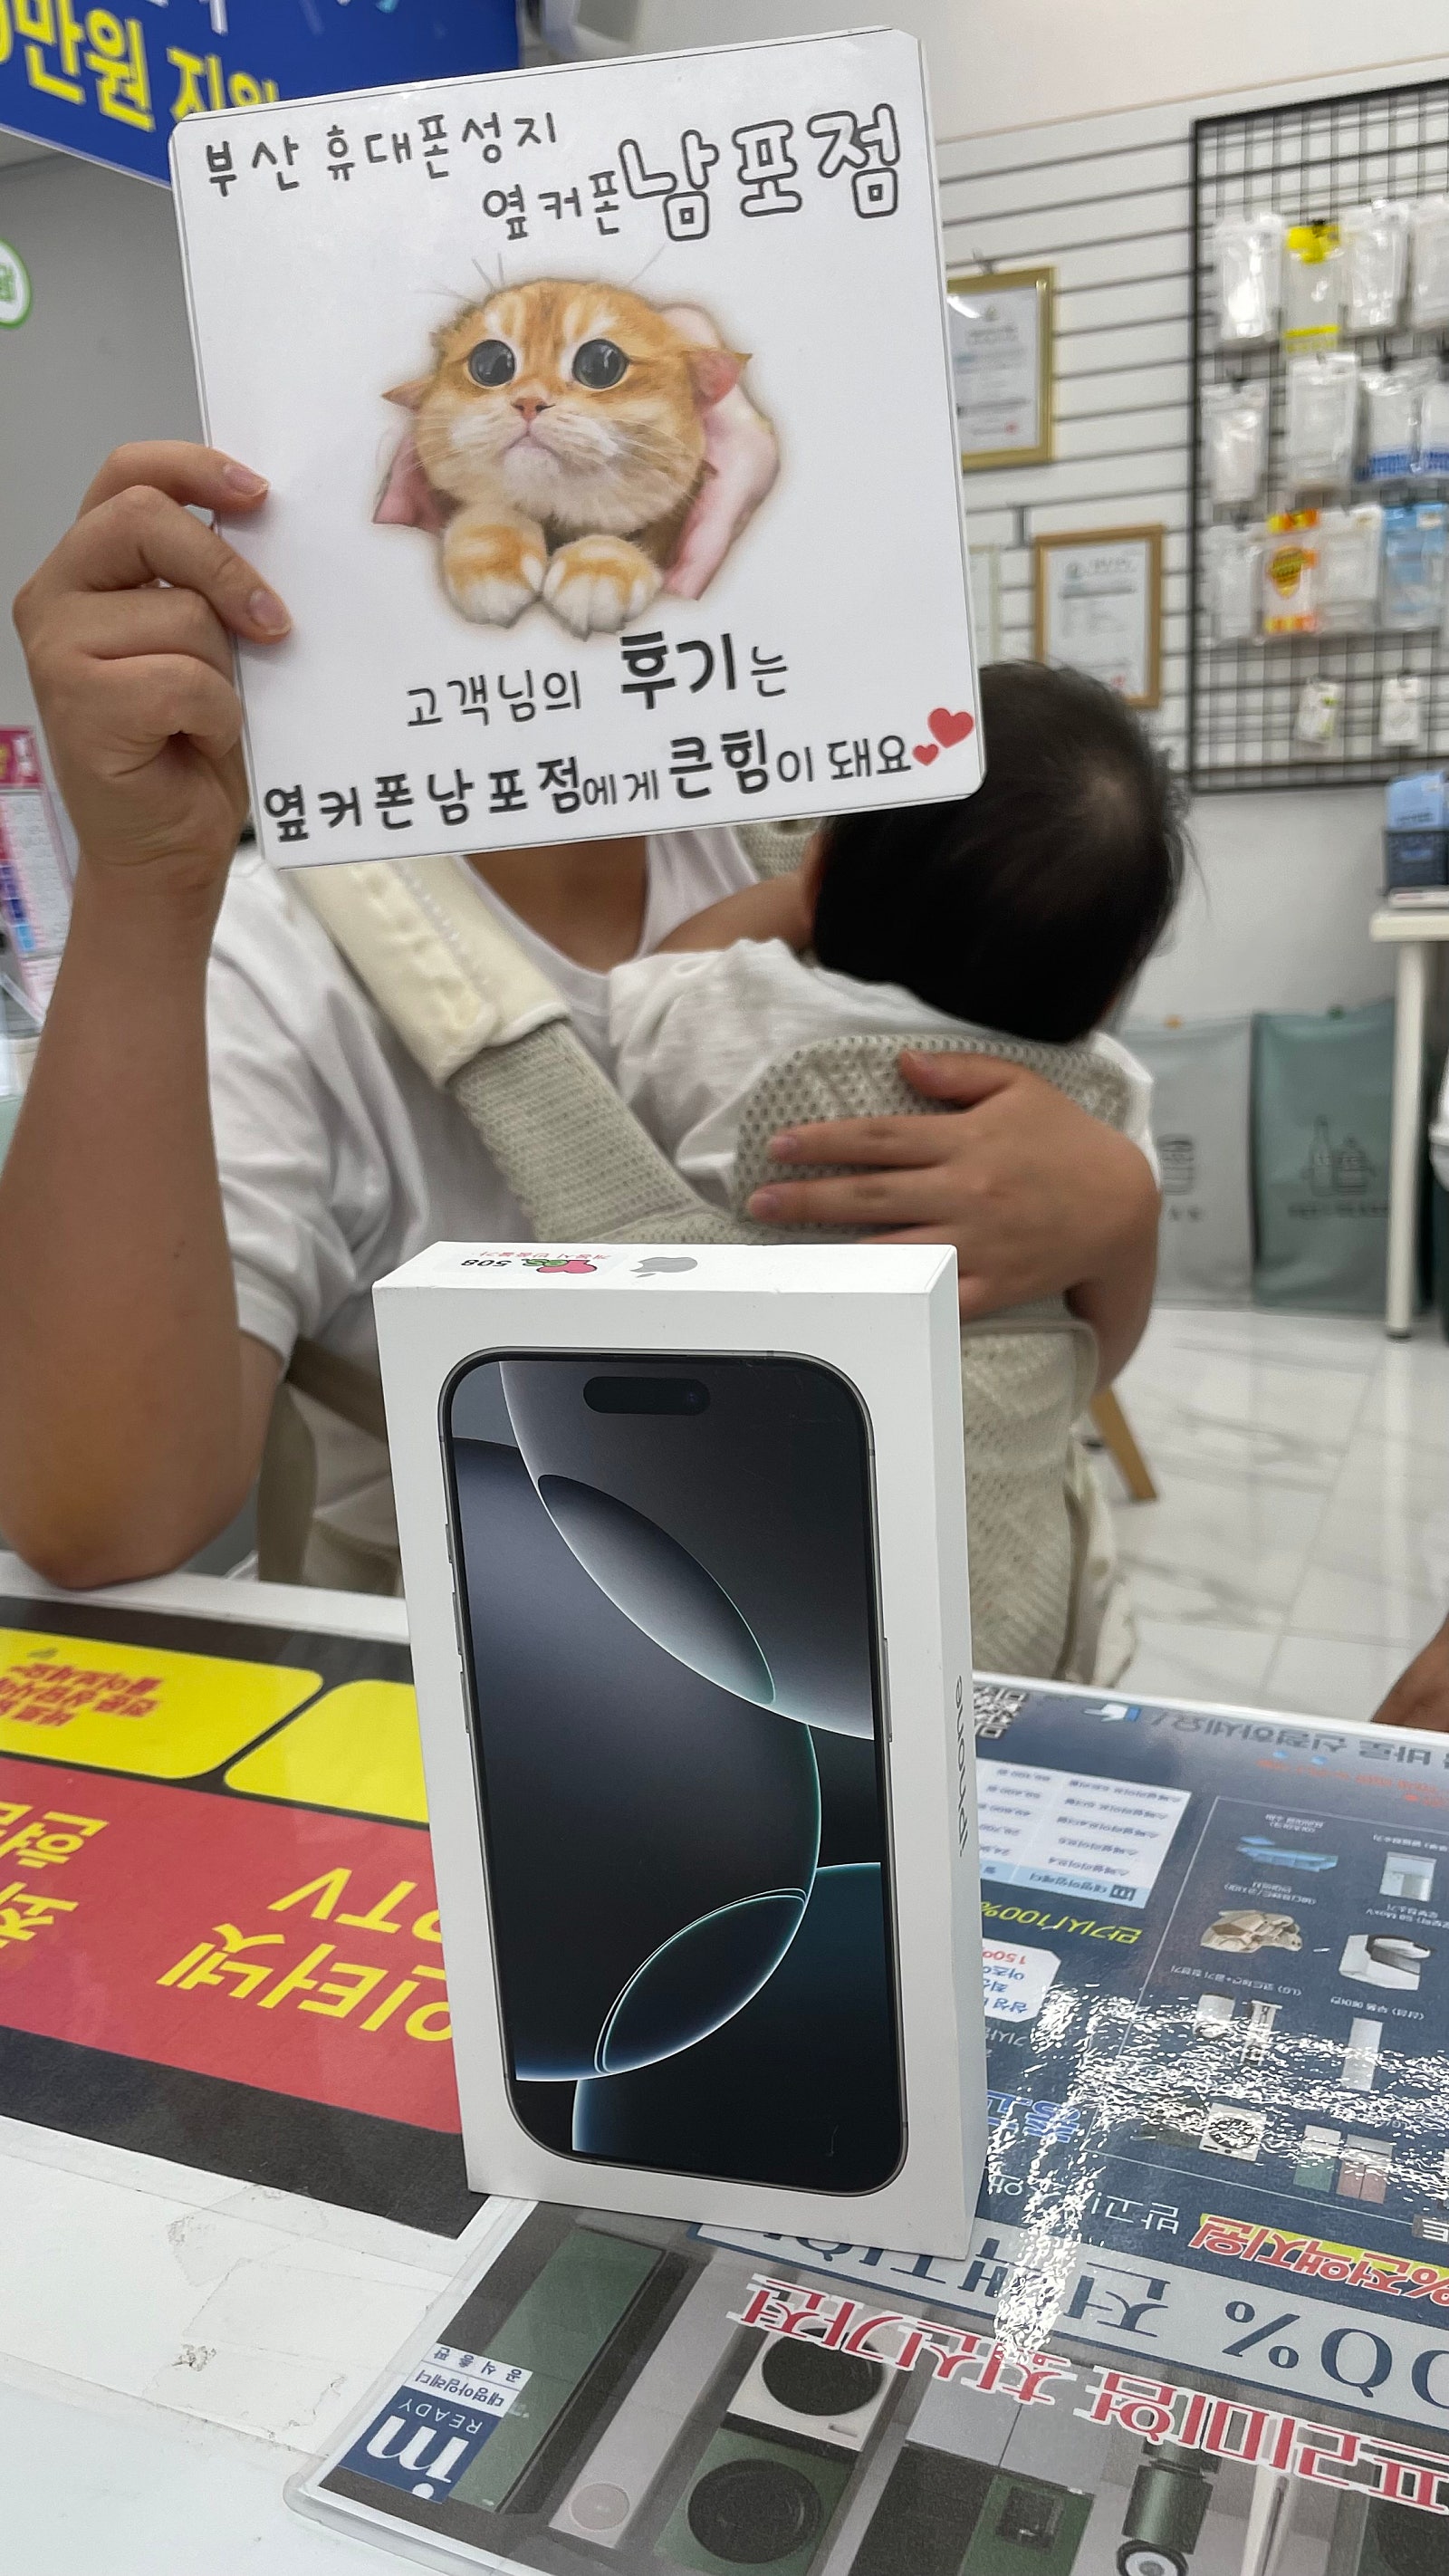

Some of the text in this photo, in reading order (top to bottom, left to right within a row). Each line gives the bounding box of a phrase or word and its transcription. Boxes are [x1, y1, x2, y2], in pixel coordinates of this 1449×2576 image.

[206, 112, 558, 197] 부산 휴대폰성지
[406, 630, 788, 727] 고객님의 후기는
[827, 735, 911, 781] 돼요
[460, 1259, 513, 1267] 508
[955, 1675, 968, 1858] iPhone
[1359, 1739, 1432, 1768] 바로
[156, 1923, 453, 2043] 인터넷
[397, 2398, 483, 2435] READY
[415, 2369, 504, 2408] 대명아임레디
[1076, 2364, 1449, 2513] 프리미엄
